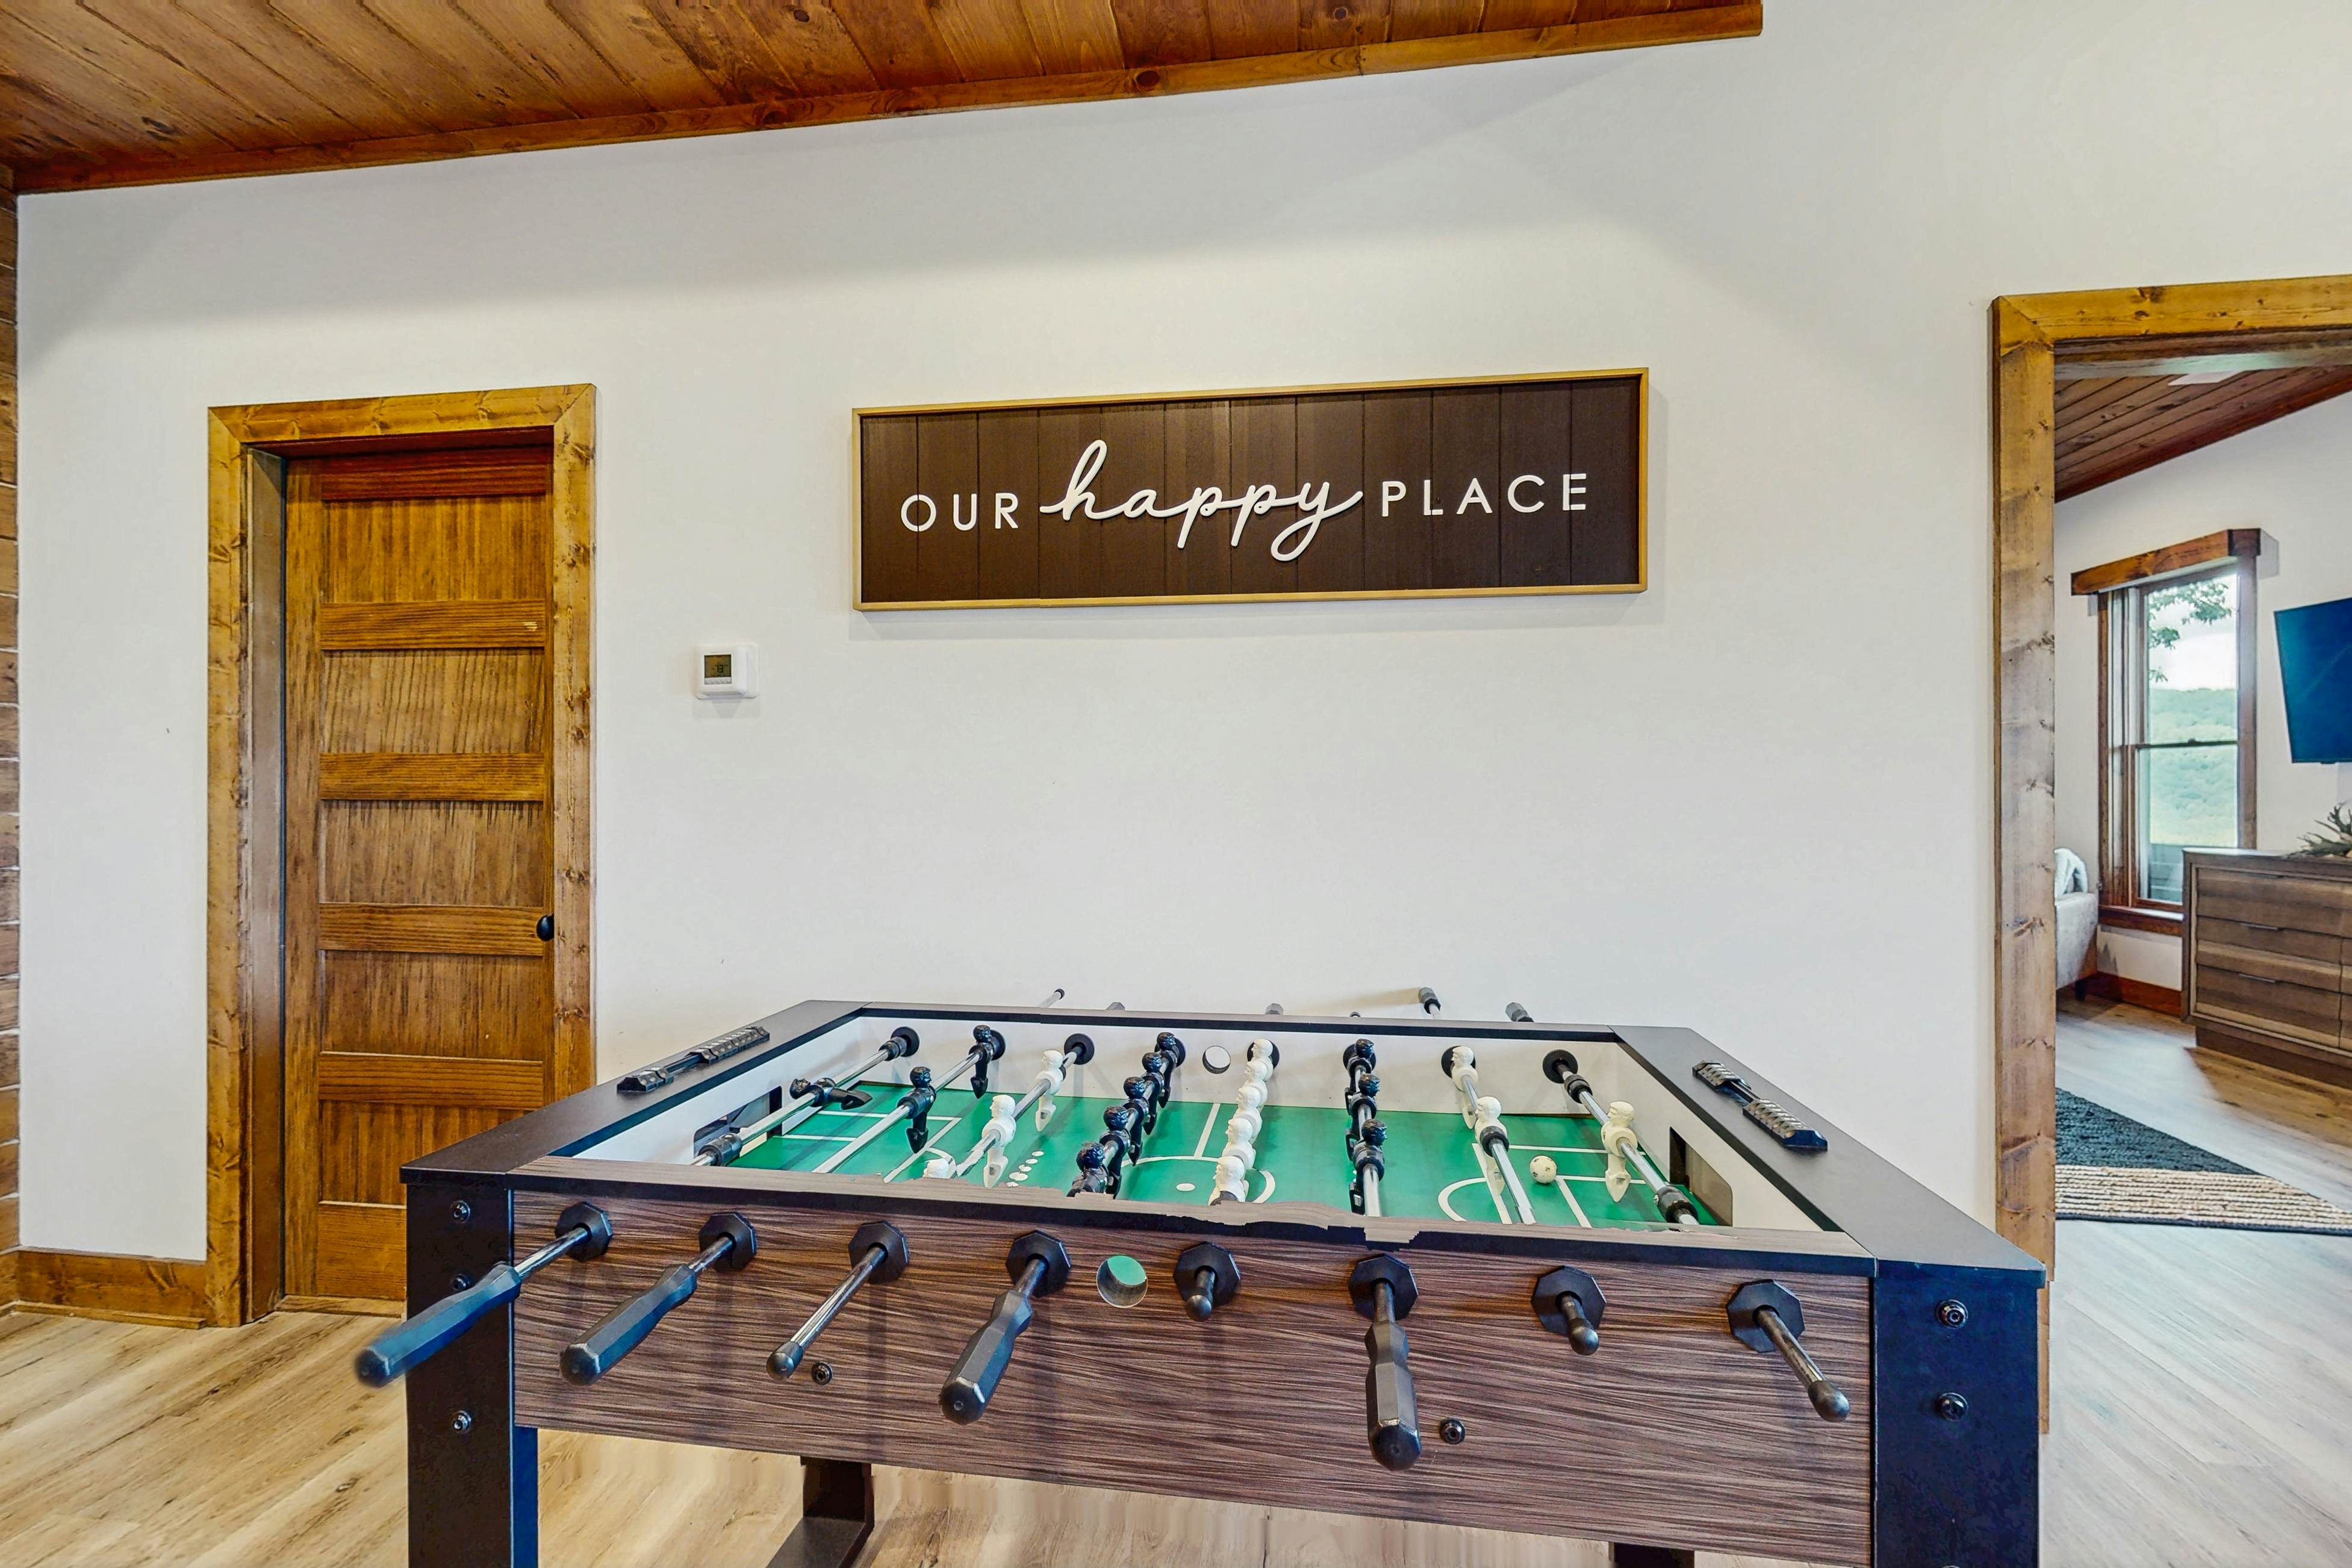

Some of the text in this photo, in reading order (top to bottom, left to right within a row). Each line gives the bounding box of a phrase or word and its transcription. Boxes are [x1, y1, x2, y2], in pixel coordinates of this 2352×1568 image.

[900, 440, 1587, 561] OUR happy PLACE
